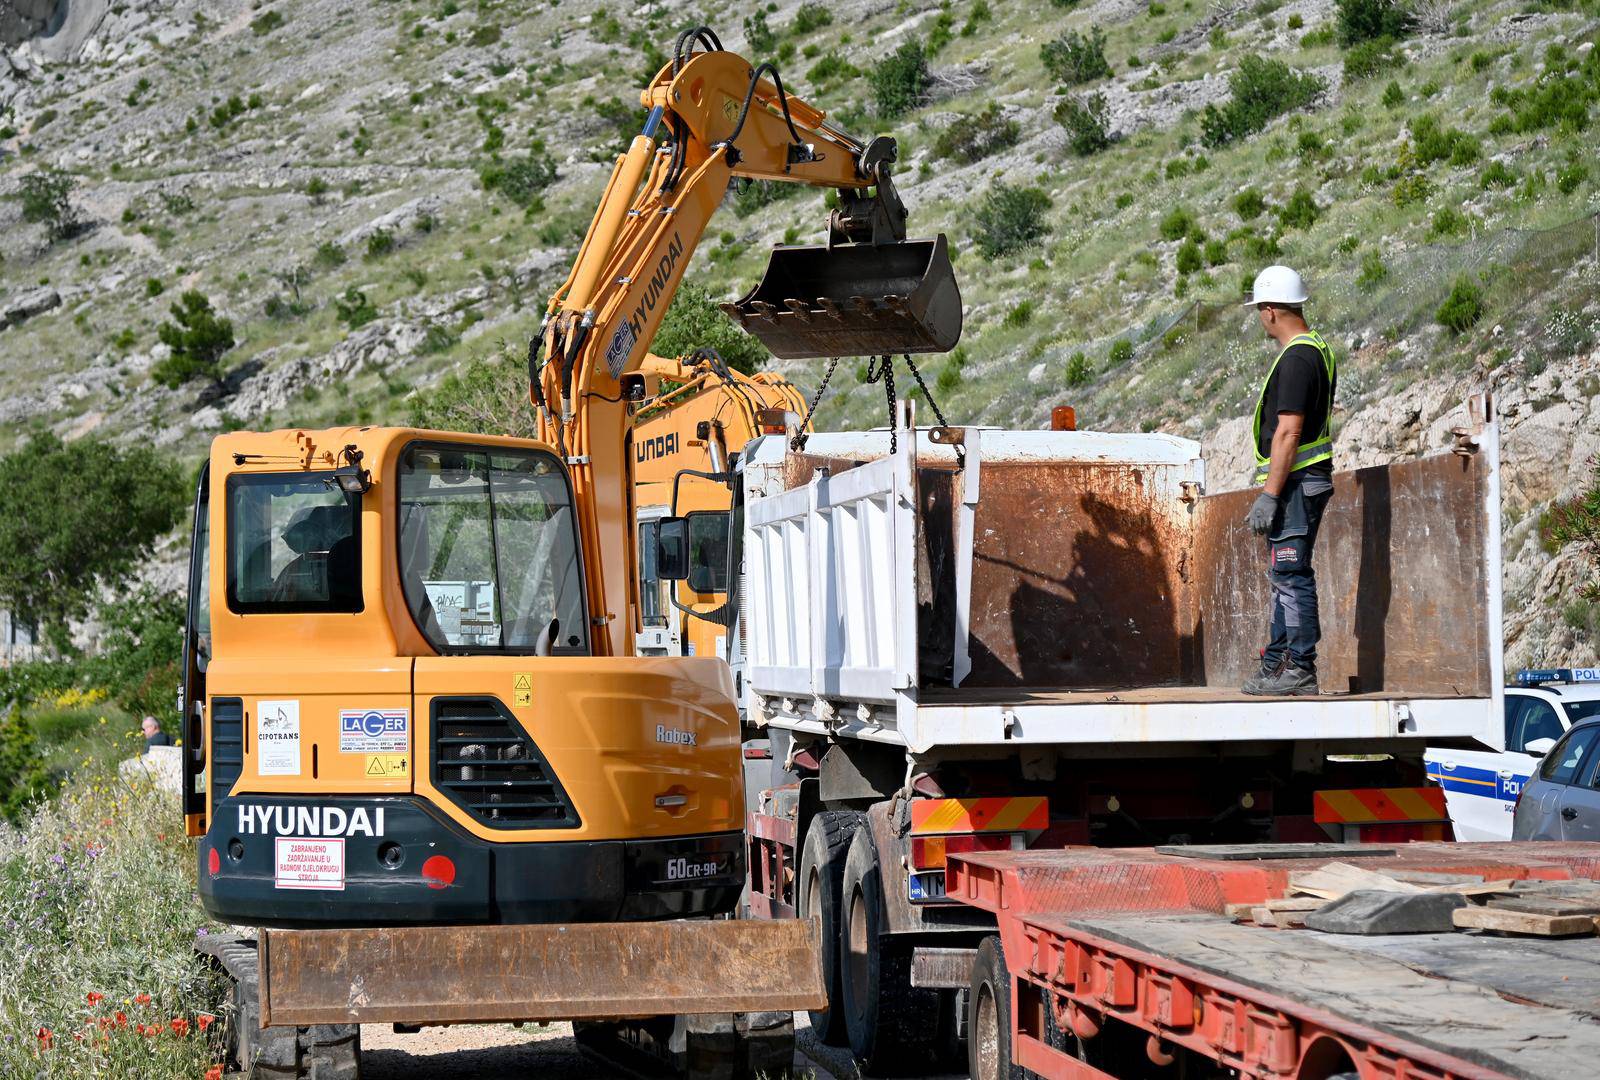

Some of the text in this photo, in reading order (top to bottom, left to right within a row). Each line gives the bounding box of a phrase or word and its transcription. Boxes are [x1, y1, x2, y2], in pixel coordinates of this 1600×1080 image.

[629, 231, 684, 343] HYUNDAI
[635, 431, 680, 463] UNDAI
[1575, 669, 1600, 680] POL
[343, 712, 404, 736] LAGER
[656, 724, 697, 746] Robex
[258, 732, 299, 740] CIPOTRANS
[1503, 780, 1525, 795] POL
[238, 804, 385, 837] HYUNDAI
[290, 844, 327, 853] ZABRANJENO
[667, 858, 717, 880] 60CR-9A
